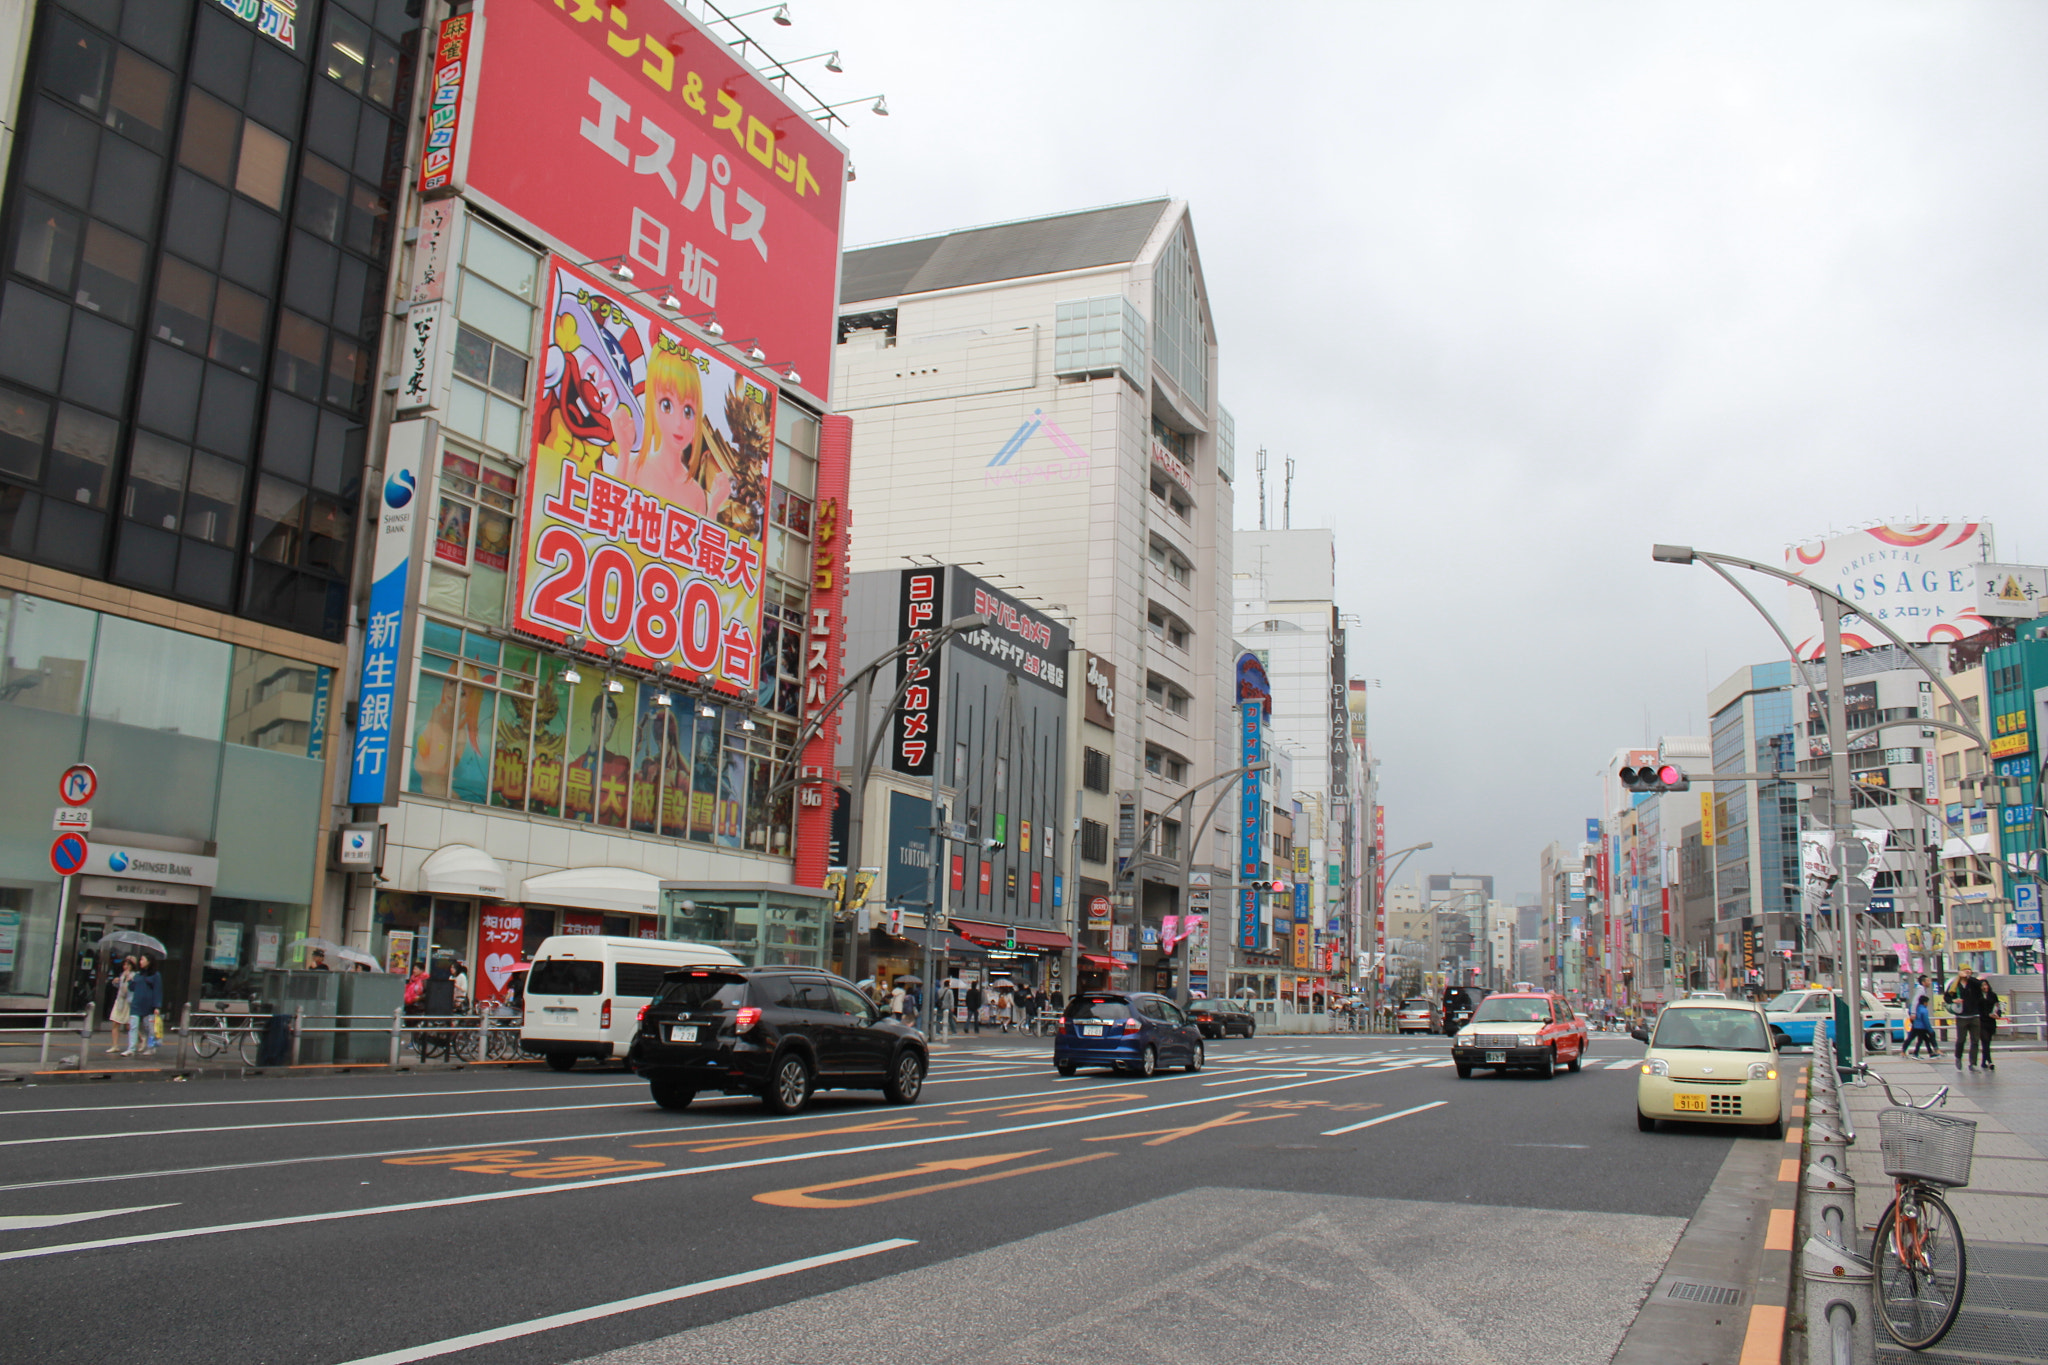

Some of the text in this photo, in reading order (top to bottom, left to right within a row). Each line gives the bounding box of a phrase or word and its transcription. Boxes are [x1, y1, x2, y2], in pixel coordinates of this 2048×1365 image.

[441, 17, 467, 63] 麻雀
[553, 0, 820, 197] ンコ&スロット
[425, 175, 446, 190] 6F
[579, 76, 768, 263] エスパス
[629, 206, 719, 308] 日拓
[984, 460, 1091, 489] NAGAFUJI
[1152, 442, 1192, 492] NAGAFUJI
[384, 513, 410, 524] SHINSEI
[386, 525, 405, 535] BANK
[545, 459, 758, 598] 上野地区最大
[814, 496, 837, 590] パチンコ
[1841, 550, 1921, 576] ORIENTAL
[529, 525, 757, 686] 2080台
[1832, 570, 1964, 601] ASSAGE
[974, 587, 1051, 650] ヨドバシカメラ
[1878, 608, 1889, 620] &
[1895, 605, 1946, 619] スロット
[804, 608, 834, 742] エスパス
[902, 574, 935, 768] ヨドバシカメラ
[960, 628, 1064, 688] ルチメディア上野2号店
[356, 609, 401, 776] 新生銀行
[1333, 684, 1344, 753] PLAZA
[494, 749, 738, 838] 地域最大級設置!!
[801, 765, 823, 807] 日拓
[60, 812, 88, 821] 8-20
[131, 859, 193, 877] SHINSEI BANK
[344, 850, 370, 859] 新生銀行
[900, 846, 930, 869] TSUTSUM
[2017, 887, 2031, 908] P
[483, 915, 522, 930] 本日10時
[485, 931, 520, 943] オープン
[381, 1150, 667, 1179] 8-20
